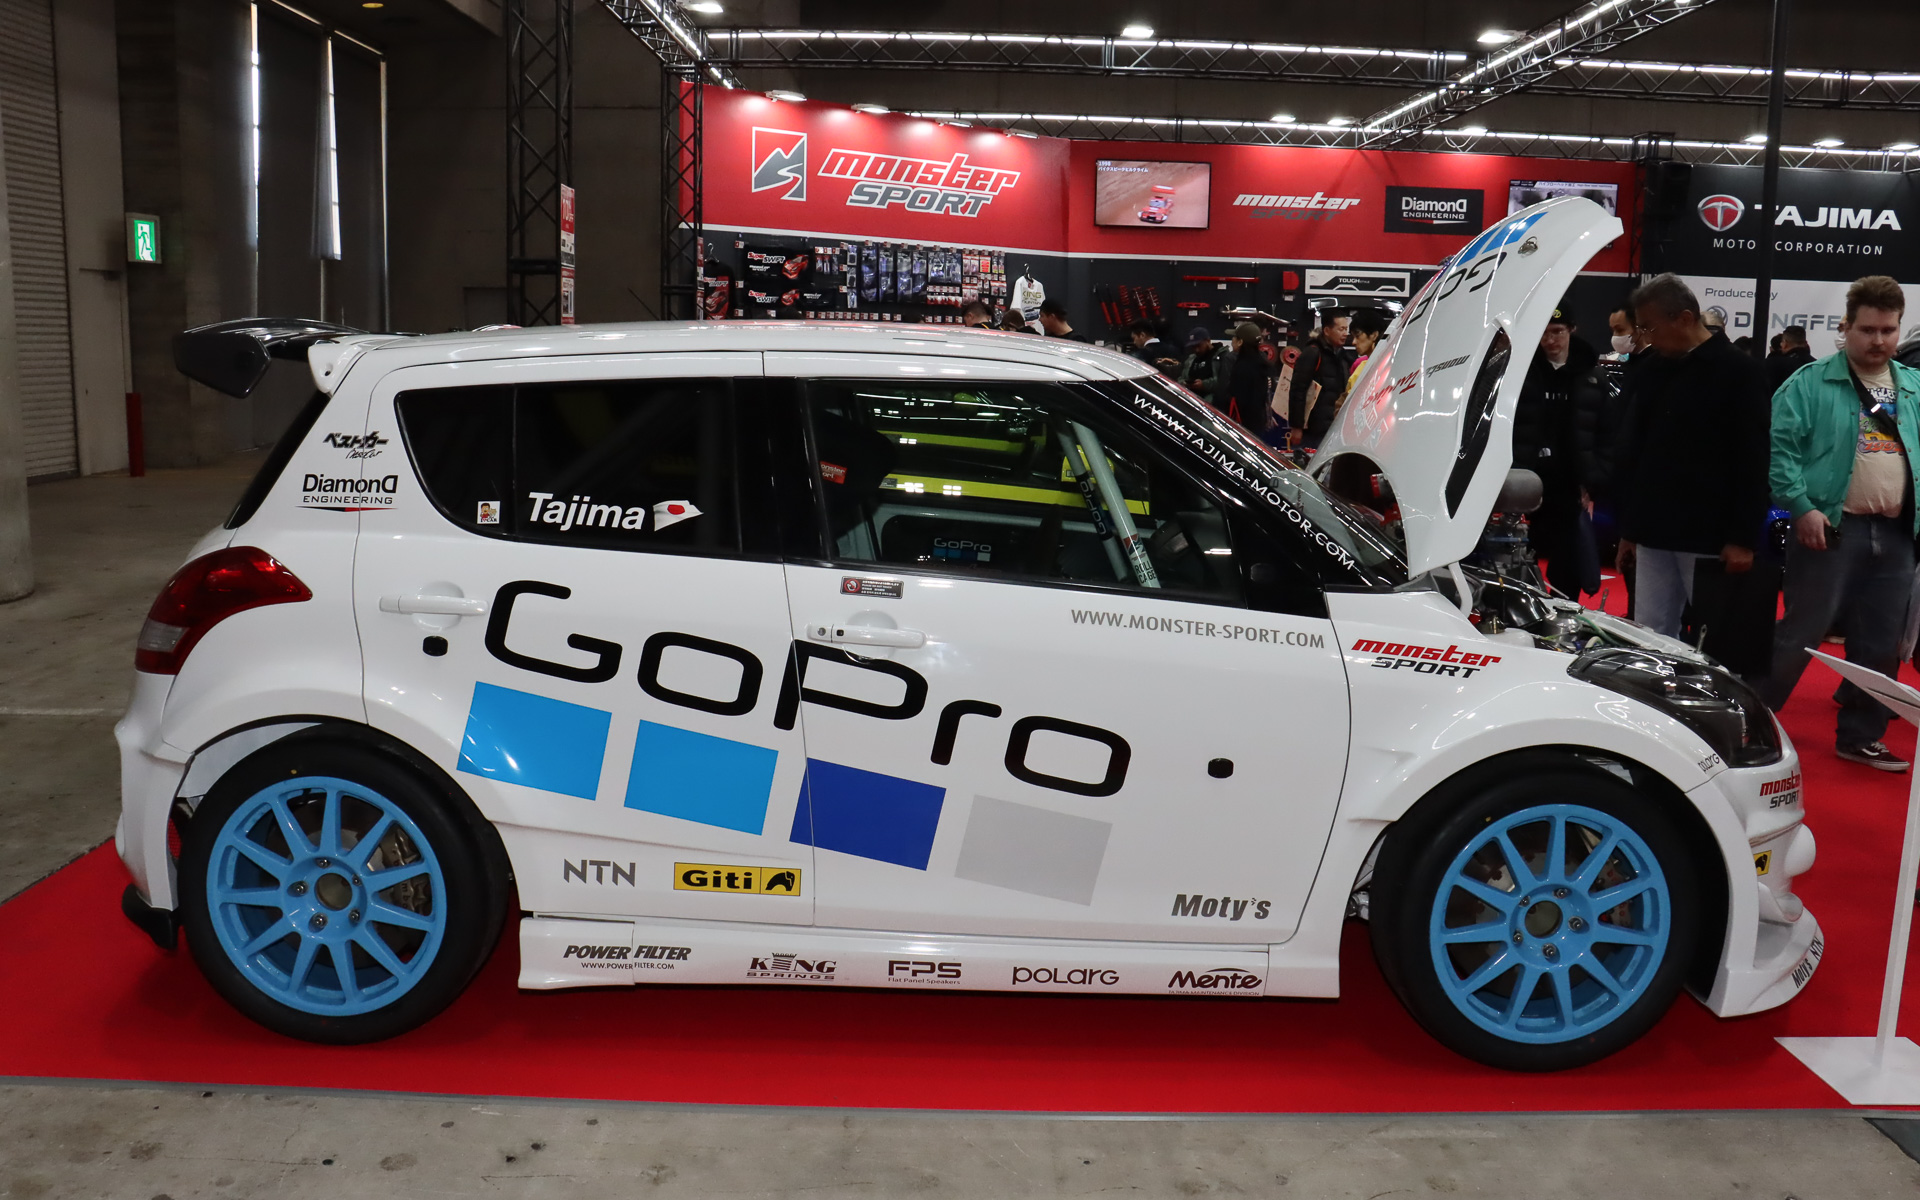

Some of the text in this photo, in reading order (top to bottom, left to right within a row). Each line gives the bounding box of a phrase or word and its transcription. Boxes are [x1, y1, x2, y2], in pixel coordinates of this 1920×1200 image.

[817, 148, 1021, 195] monster
[845, 180, 993, 218] SPORT
[1232, 192, 1362, 211] monster
[1250, 208, 1342, 221] SPORT
[1402, 211, 1465, 220] ENGINEERING
[1754, 204, 1902, 231] AJIMA
[1713, 238, 1883, 255] MOTO CORPORATION
[1705, 288, 1757, 298] Produce
[302, 495, 393, 505] ENGINEERING
[528, 491, 646, 532] Tajima
[934, 537, 992, 552] GoPro
[1071, 608, 1325, 649] WWW.MONSTER-SPORT.COM
[1351, 638, 1502, 667] monster
[1371, 655, 1481, 679] SPORT
[484, 580, 1131, 797] GoPro
[563, 859, 636, 888] NTN
[681, 868, 753, 891] Giti
[1171, 893, 1272, 921] Moty's
[563, 945, 692, 961] POWER FILTER
[888, 960, 962, 978] FPS
[1168, 970, 1262, 989] Mente
